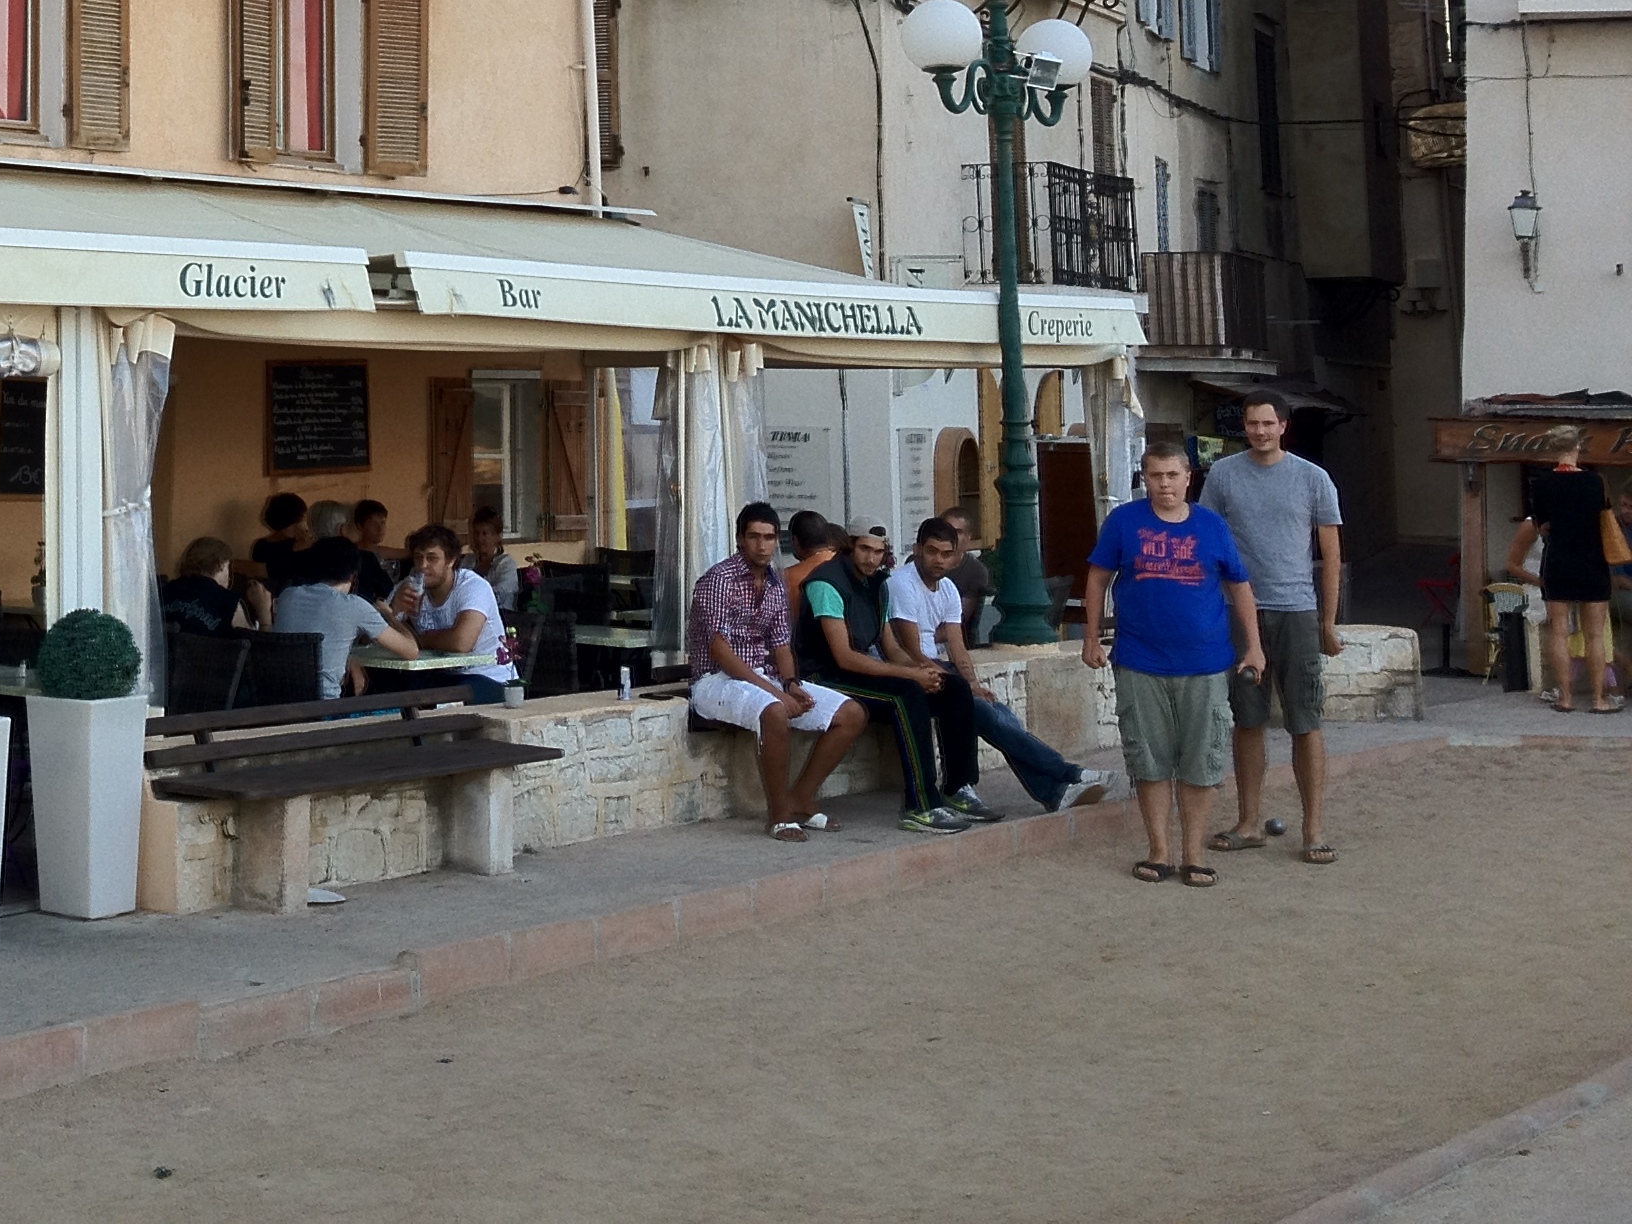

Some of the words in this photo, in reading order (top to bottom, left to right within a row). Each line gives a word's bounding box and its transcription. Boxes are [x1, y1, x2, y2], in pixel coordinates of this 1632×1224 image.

[179, 262, 286, 299] Glacier
[496, 278, 542, 310] Bar
[711, 295, 753, 329] LA
[752, 297, 924, 336] MANICHELLA
[1027, 310, 1093, 343] Creperie
